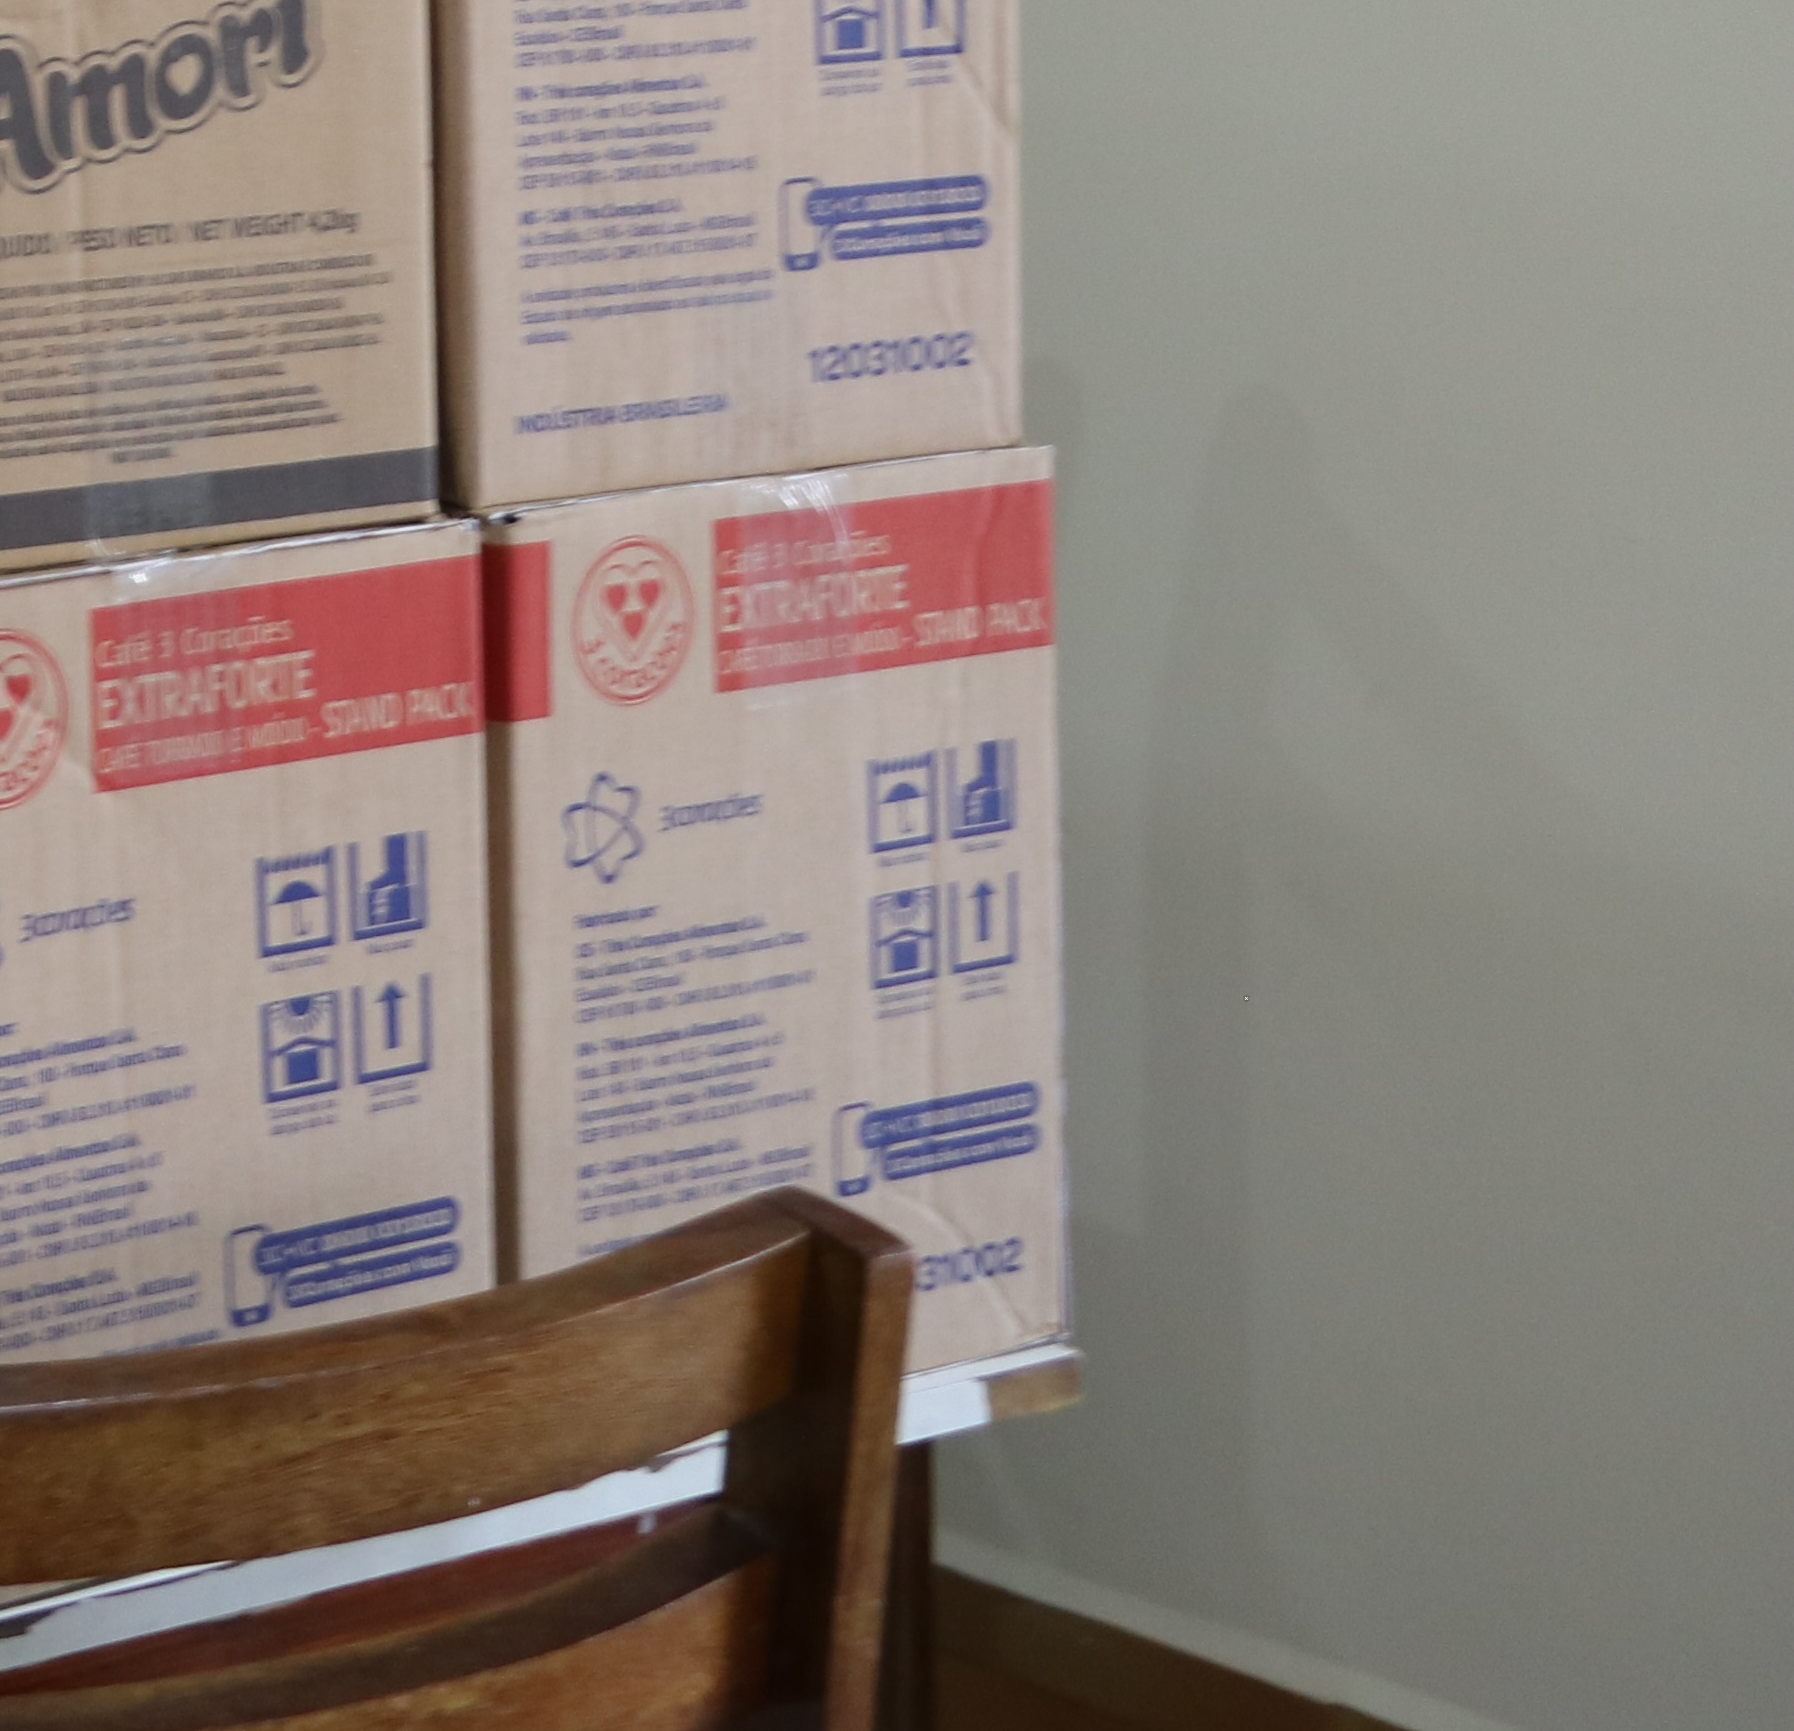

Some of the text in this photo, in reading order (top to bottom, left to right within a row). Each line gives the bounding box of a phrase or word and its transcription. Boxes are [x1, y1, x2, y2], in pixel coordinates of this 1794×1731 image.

[231, 212, 307, 239] WEIGHT
[809, 330, 974, 384] 12031002
[720, 563, 911, 634] EXTRAFORTE
[915, 605, 983, 647] STAND
[984, 597, 1047, 636] PACK
[95, 615, 294, 668] Café 3 Corações
[95, 649, 316, 730] EXTRAFORTE
[321, 692, 405, 739] STAND
[407, 680, 475, 725] PACK
[915, 1235, 1025, 1293] 31002
